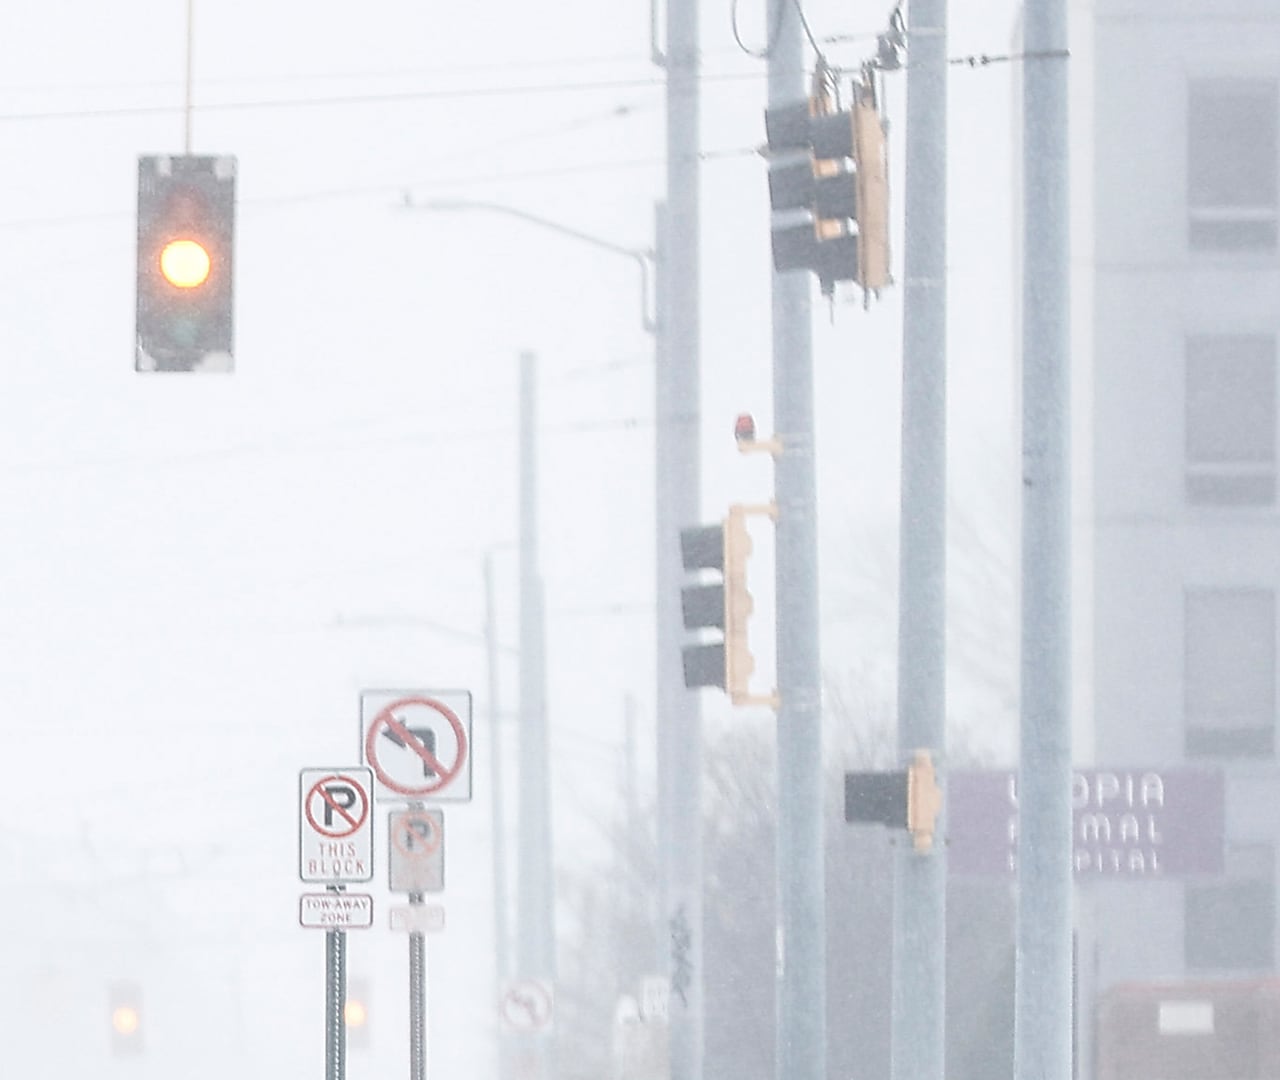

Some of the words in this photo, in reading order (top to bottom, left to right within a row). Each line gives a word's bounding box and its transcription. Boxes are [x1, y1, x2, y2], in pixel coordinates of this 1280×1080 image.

[319, 842, 356, 857] THIS
[308, 859, 365, 875] BLOCK
[320, 912, 352, 923] ZONE
